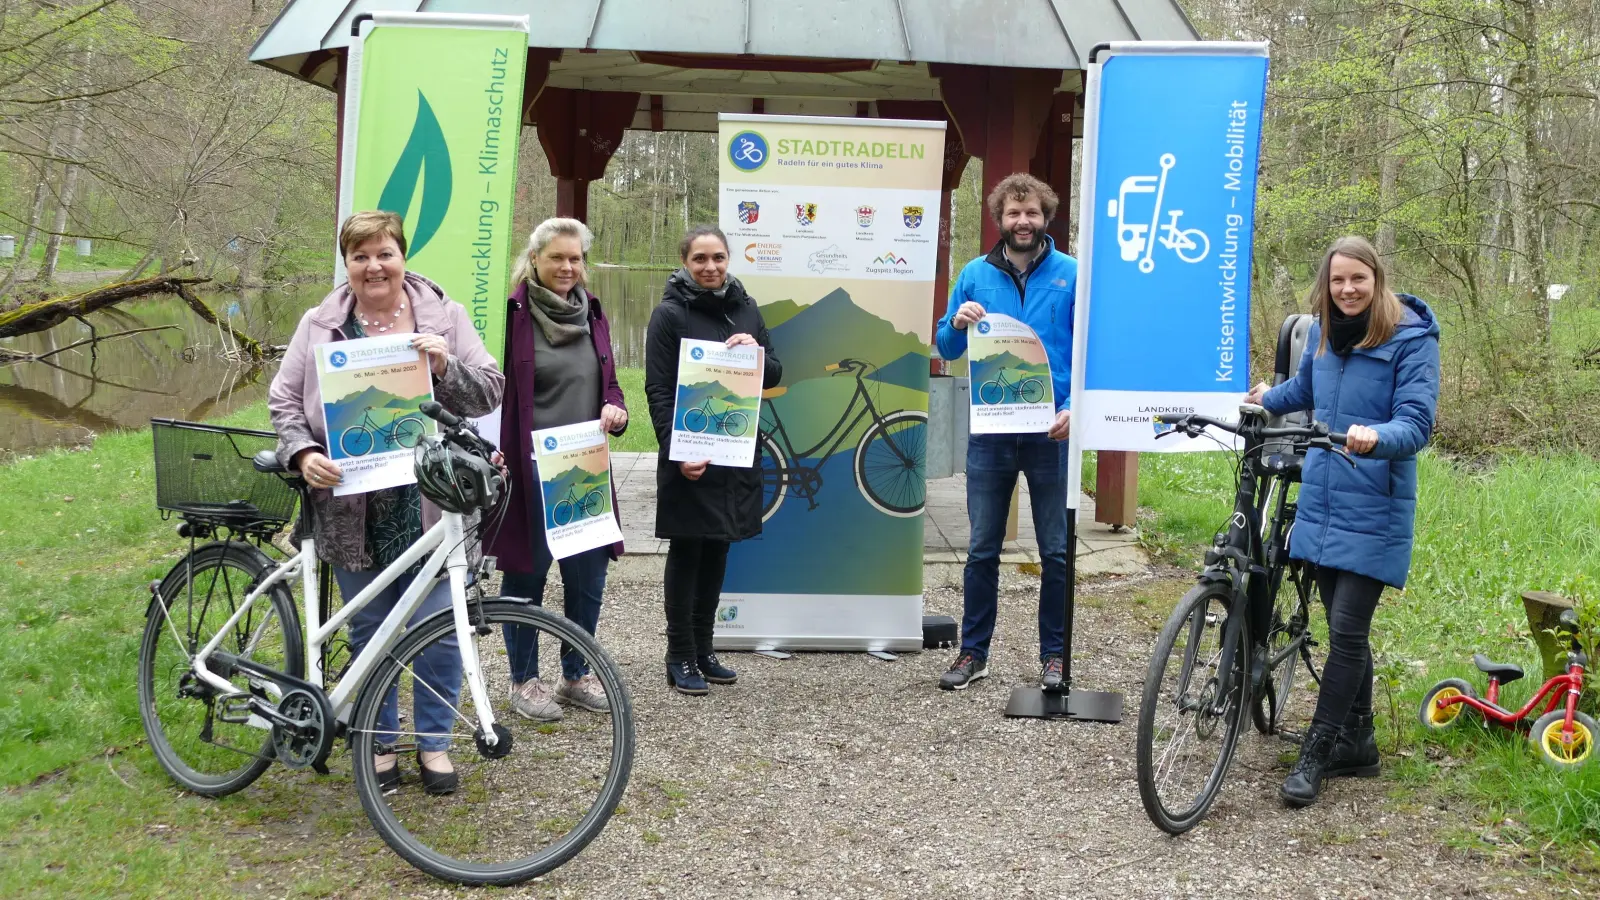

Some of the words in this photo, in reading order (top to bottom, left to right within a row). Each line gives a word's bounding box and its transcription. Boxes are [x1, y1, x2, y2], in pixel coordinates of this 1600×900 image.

[478, 48, 508, 174] Klimaschutz
[777, 138, 924, 160] STADTRADELN
[1223, 100, 1248, 191] Mobilität
[777, 158, 806, 166] Radeln
[807, 159, 819, 167] für
[821, 160, 834, 168] ein
[835, 161, 859, 170] gutes
[860, 161, 884, 170] Klima
[486, 181, 490, 194] –
[1231, 196, 1235, 208] –
[472, 200, 499, 343] sentwicklung
[865, 266, 892, 275] Zugspitz
[893, 267, 914, 275] Region
[1216, 214, 1243, 382] Kreisentwicklung
[707, 349, 755, 361] STADTRADELN
[364, 370, 376, 378] Mai
[402, 365, 418, 373] 2023
[1138, 406, 1195, 414] LANDKREIS
[1104, 415, 1150, 423] WEILHEIM
[339, 460, 354, 468] Jetzt
[388, 450, 414, 460] stadtrad
[345, 465, 358, 473] rauf
